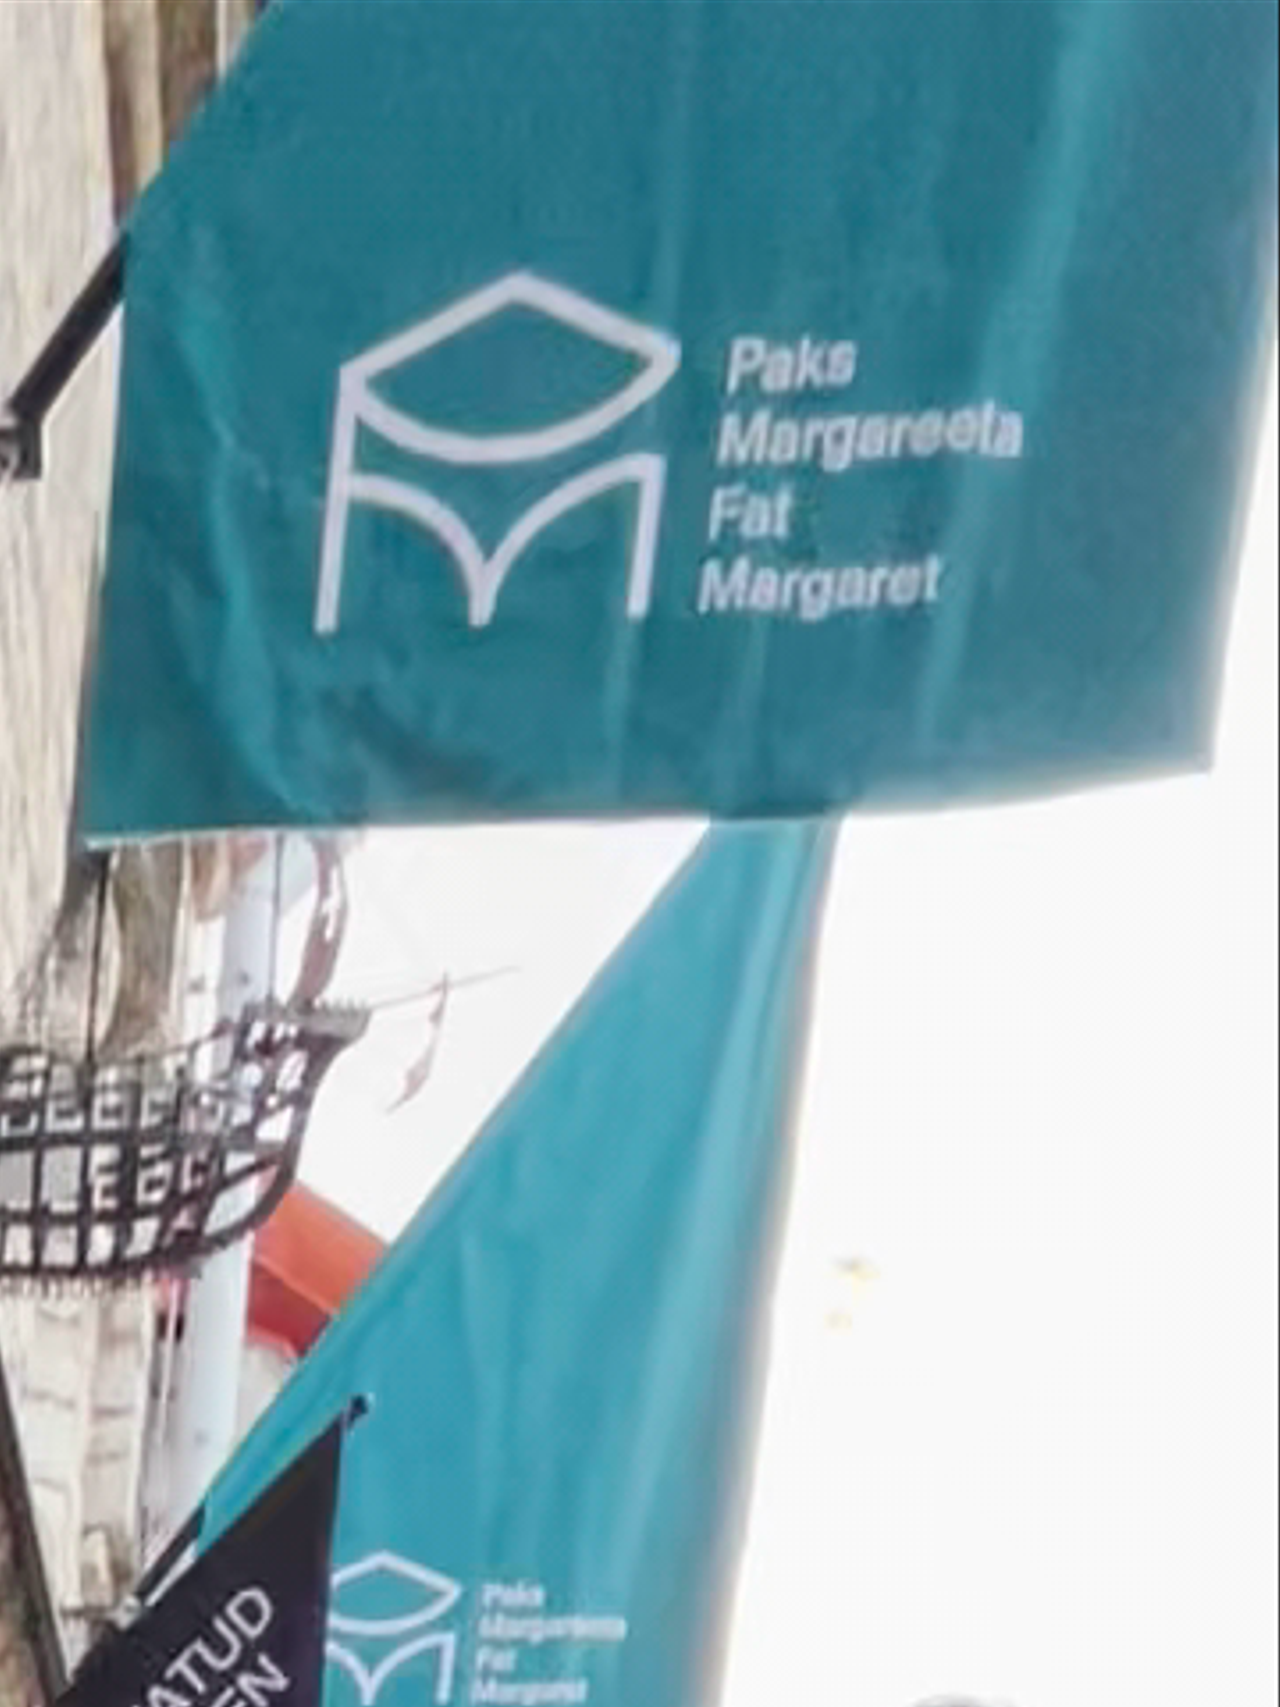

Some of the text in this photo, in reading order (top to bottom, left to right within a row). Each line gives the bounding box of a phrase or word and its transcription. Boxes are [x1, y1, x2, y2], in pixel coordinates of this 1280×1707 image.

[727, 333, 858, 394] Paks
[715, 400, 1025, 472] Margareeta
[709, 483, 793, 541] Fat
[696, 553, 944, 624] Margaret
